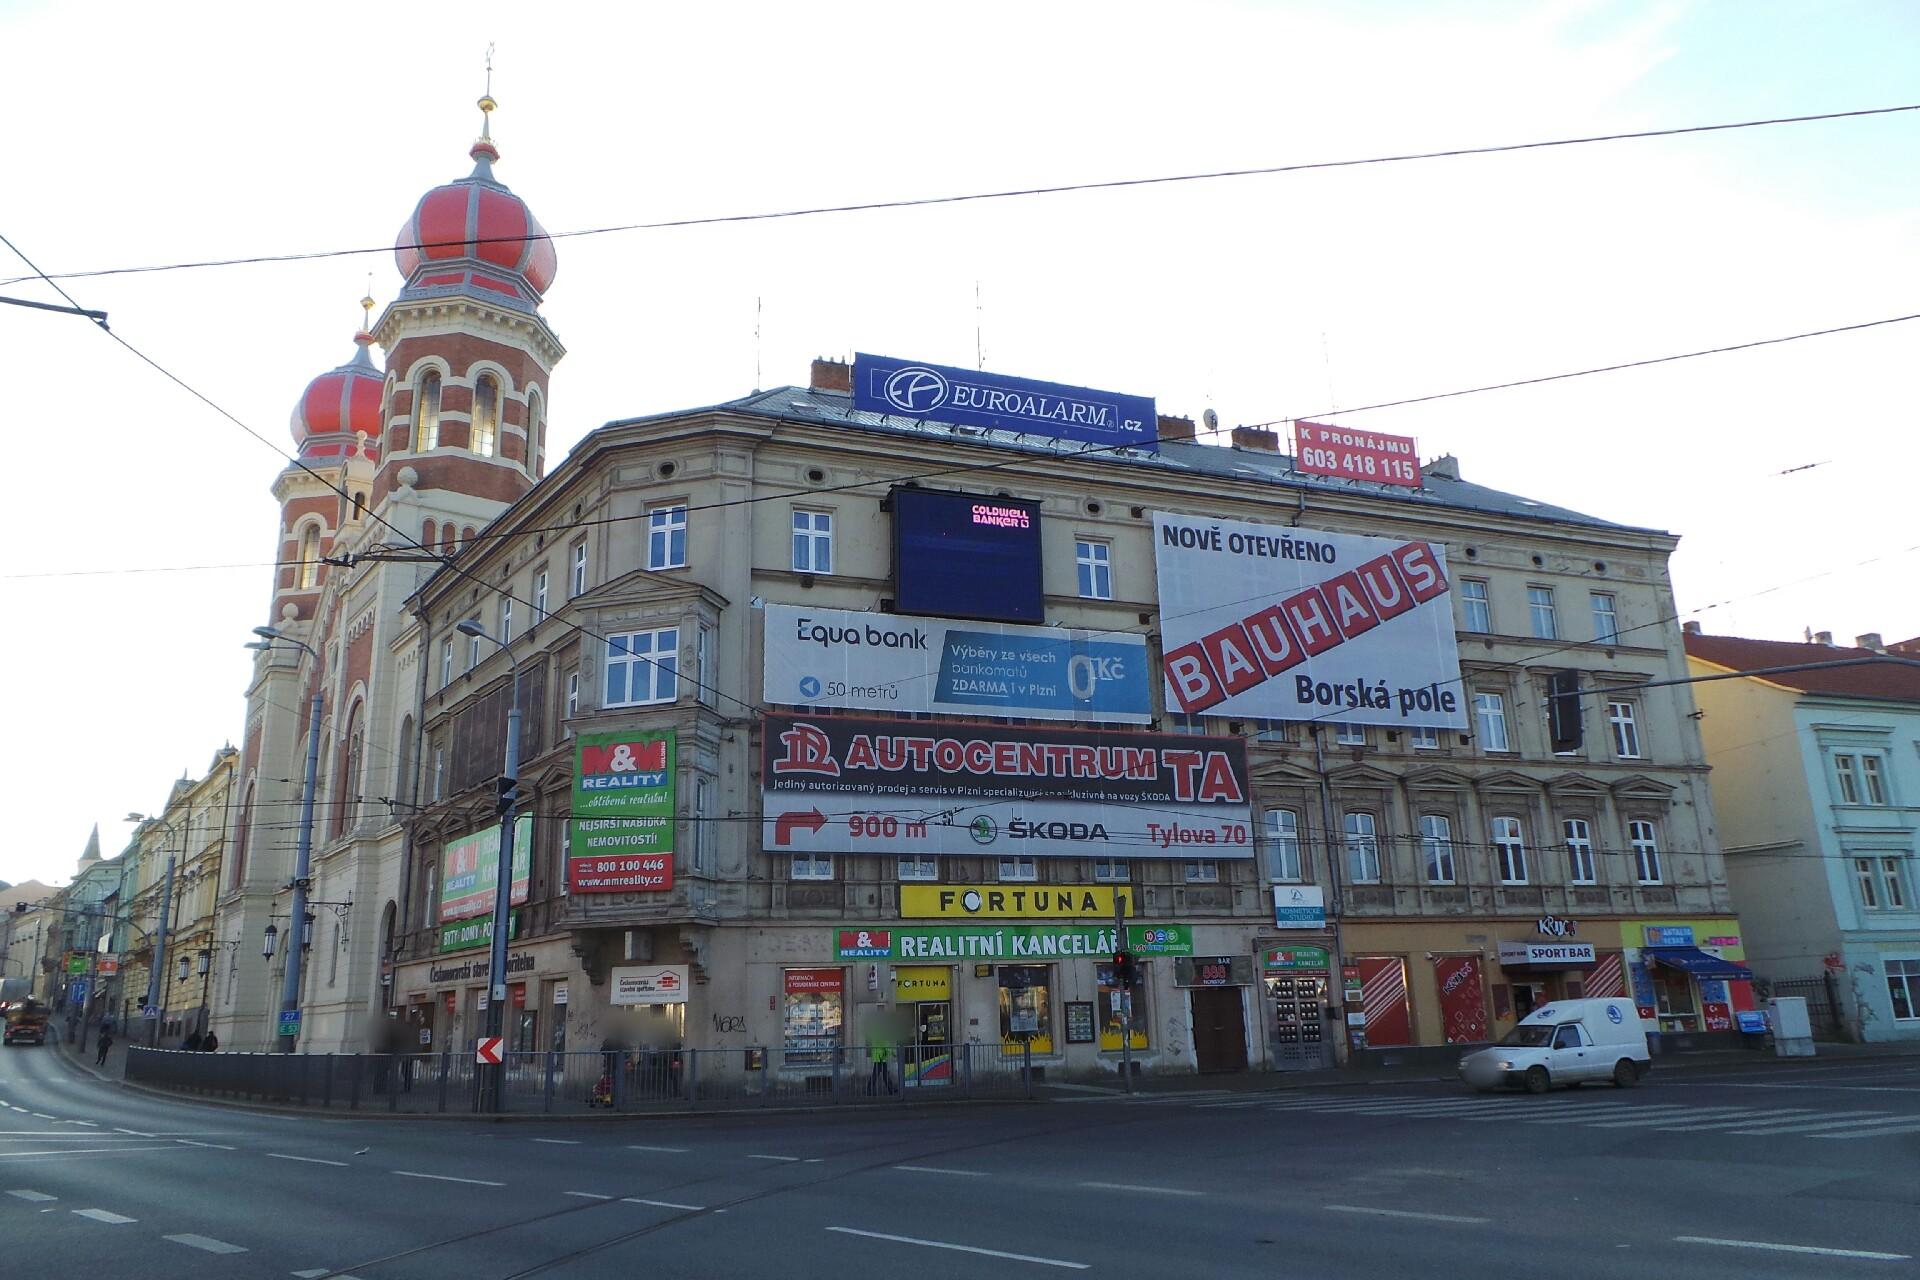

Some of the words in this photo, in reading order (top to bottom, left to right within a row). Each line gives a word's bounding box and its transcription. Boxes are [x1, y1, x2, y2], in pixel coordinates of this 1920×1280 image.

[952, 385, 1108, 426] EUROALARM
[1300, 428, 1311, 440] K
[1320, 431, 1410, 454] PRONÁJMU
[1303, 447, 1337, 469] 603
[1343, 453, 1376, 475] 418
[1381, 458, 1414, 480] 115
[1163, 524, 1221, 552] NOVĚ
[1229, 533, 1336, 564] OTEVŘENO
[798, 618, 861, 648] Equa
[865, 624, 928, 650] bank
[1169, 548, 1437, 704] BAUHAUS
[951, 644, 997, 661] Výběry
[1001, 651, 1015, 661] ze
[1020, 649, 1056, 663] všech
[952, 662, 1027, 679] bankomatů
[1068, 654, 1096, 700] 0
[1099, 656, 1126, 680] Kč
[827, 682, 845, 697] 50
[851, 684, 898, 700] metrů
[952, 679, 1008, 694] ZDARMA
[1019, 686, 1026, 694] v
[1029, 684, 1056, 697] Plzni
[1295, 674, 1390, 709] Borská
[1398, 684, 1456, 716] pole
[845, 734, 1158, 781] AUTOCENTRUM
[1162, 750, 1243, 803] TA
[583, 773, 664, 789] REALITY
[773, 779, 806, 790] Jediný
[809, 782, 875, 793] autorizovaný
[877, 783, 909, 795] prodej
[919, 785, 947, 794] servis
[958, 786, 981, 795] Plzni
[1119, 793, 1139, 802] vozy
[850, 815, 897, 838] 900
[905, 822, 927, 838] m
[1008, 817, 1109, 840] ŠKODA
[1147, 822, 1216, 848] Tylova
[1221, 825, 1246, 844] 70
[587, 832, 657, 849] NEMOVITOSTÍ!
[597, 861, 616, 873] 800
[620, 860, 640, 871] 100
[643, 859, 664, 870] 446
[578, 875, 663, 887] www.mmreality.cz
[940, 890, 1099, 912] FORTUNA
[462, 924, 480, 942] DOMY
[901, 930, 1003, 957] REALITNÍ
[840, 949, 889, 957] REALITY
[1532, 948, 1566, 958] SPORT
[1569, 947, 1591, 957] BAR
[897, 980, 946, 988] FORTUNA
